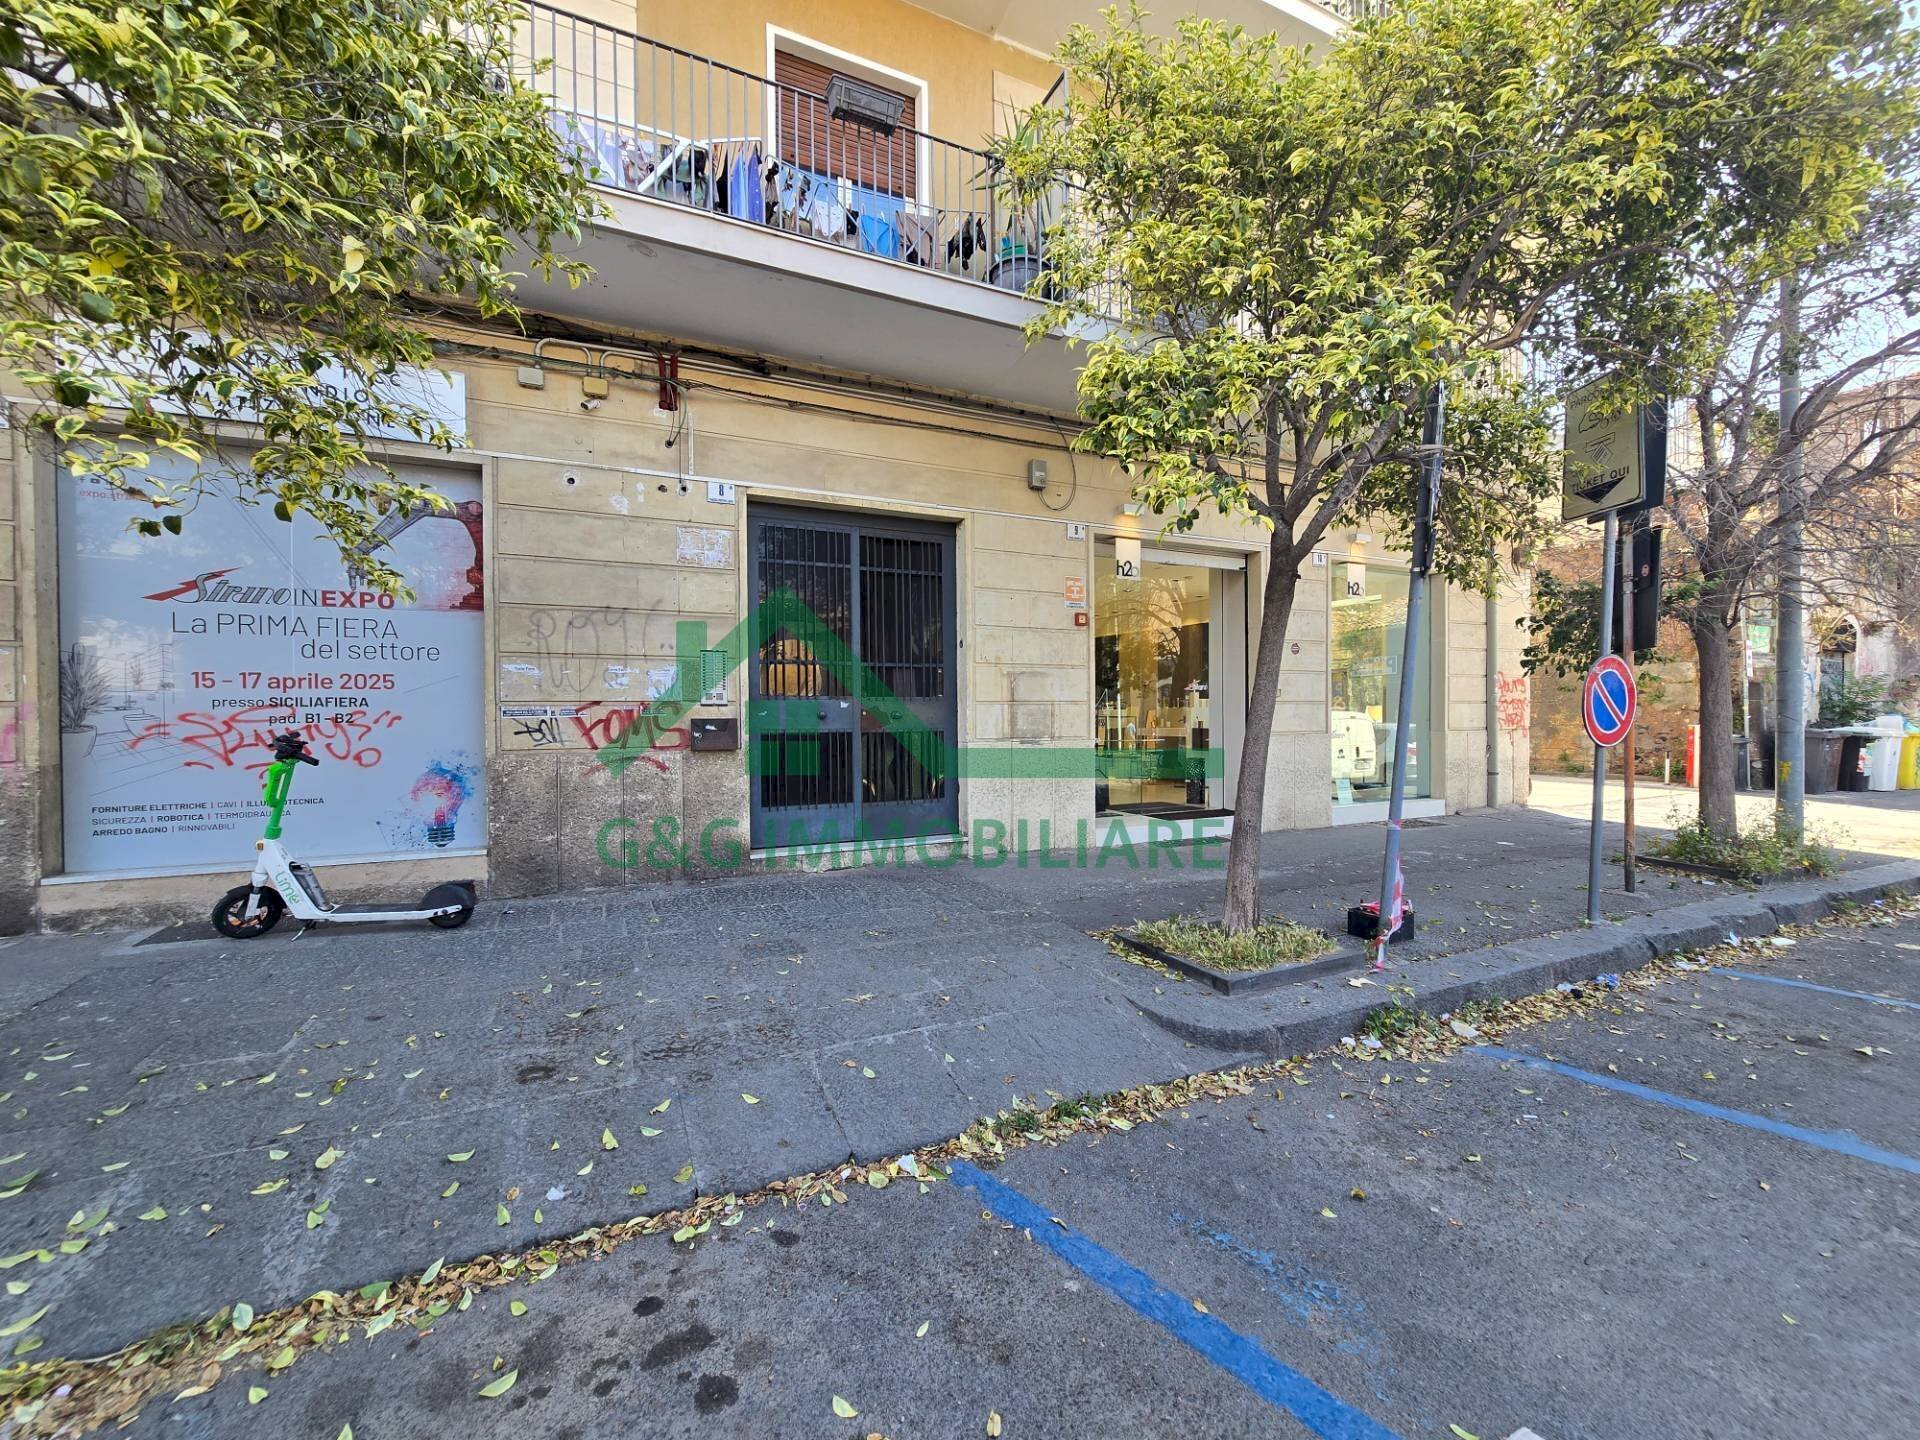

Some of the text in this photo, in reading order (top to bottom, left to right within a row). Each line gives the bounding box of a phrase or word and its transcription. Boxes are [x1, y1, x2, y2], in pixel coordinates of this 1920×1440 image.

[1610, 465, 1630, 479] QUI
[719, 484, 725, 496] 8
[171, 611, 399, 639] La PRIMA FIERA
[301, 639, 440, 662] del settore
[191, 671, 216, 689] 15
[240, 671, 262, 690] 17
[267, 672, 334, 693] aprile
[339, 673, 395, 690] 2025
[212, 696, 369, 709] presso SICILIAFIERA
[269, 713, 300, 725] pad.
[305, 713, 321, 724] B1
[334, 713, 354, 724] B2
[91, 803, 148, 814] FORNITURE
[149, 801, 208, 812] ELETTRICHE
[91, 815, 147, 826] SICUREZZA
[156, 813, 204, 822] ROBOTICA
[92, 823, 235, 837] ARREDO BAGNO RINNOVABILI
